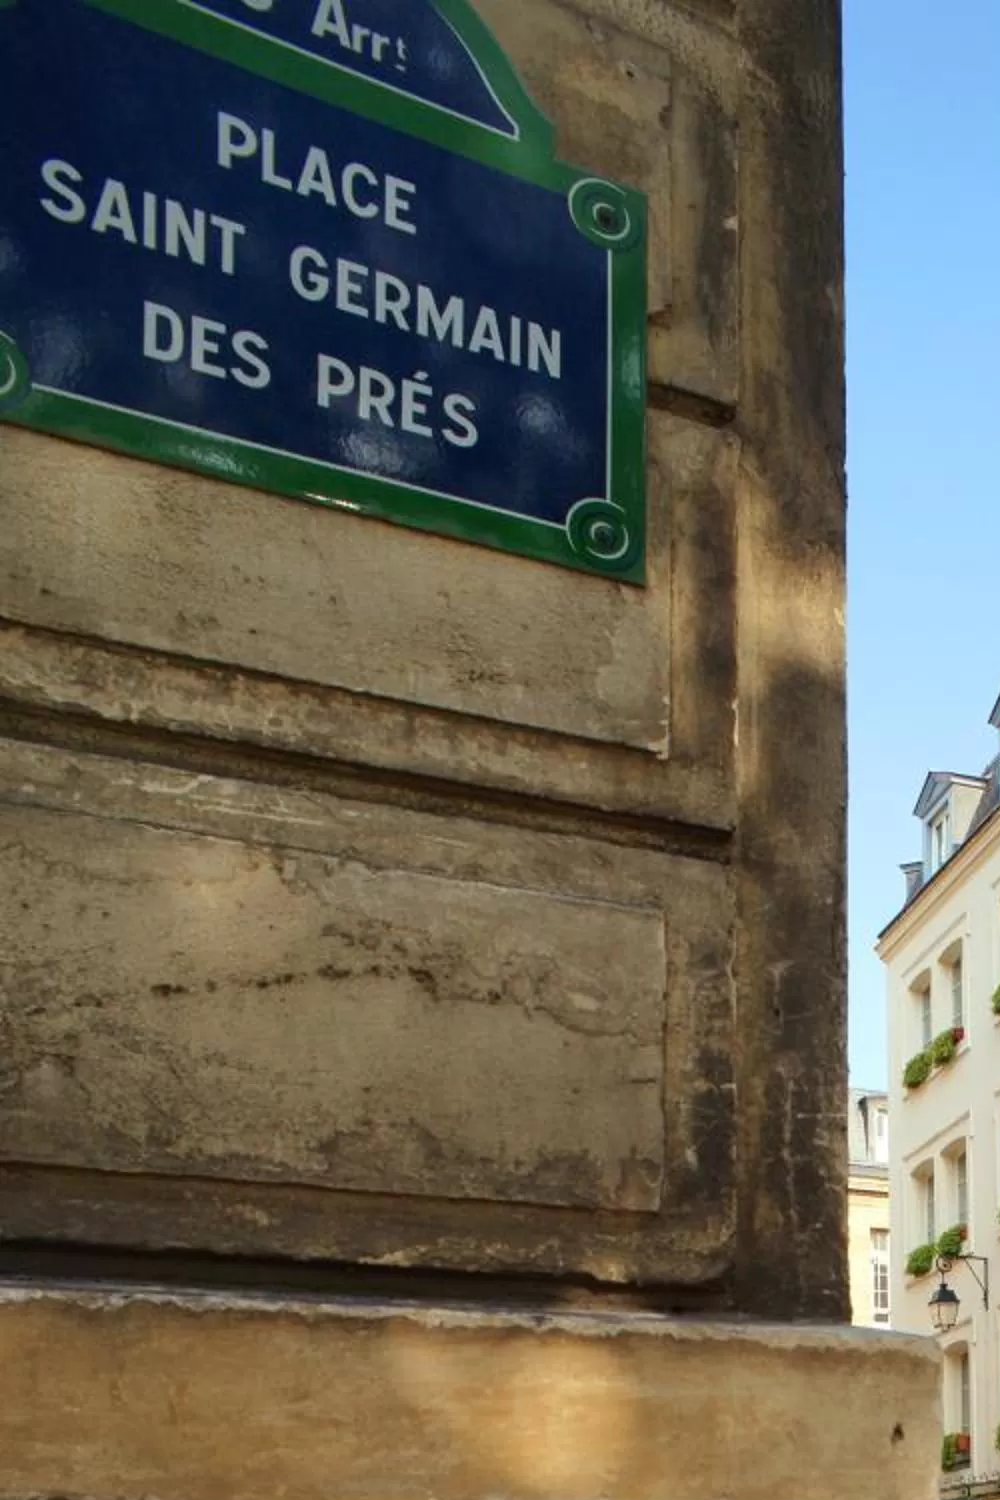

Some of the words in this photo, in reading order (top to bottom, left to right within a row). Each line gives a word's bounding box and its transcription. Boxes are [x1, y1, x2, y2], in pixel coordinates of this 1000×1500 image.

[217, 110, 417, 235] PLACE
[40, 158, 246, 275] SAINT
[289, 245, 562, 380] GERMAIN
[142, 300, 272, 390] DES
[316, 352, 479, 448] PRÉS
